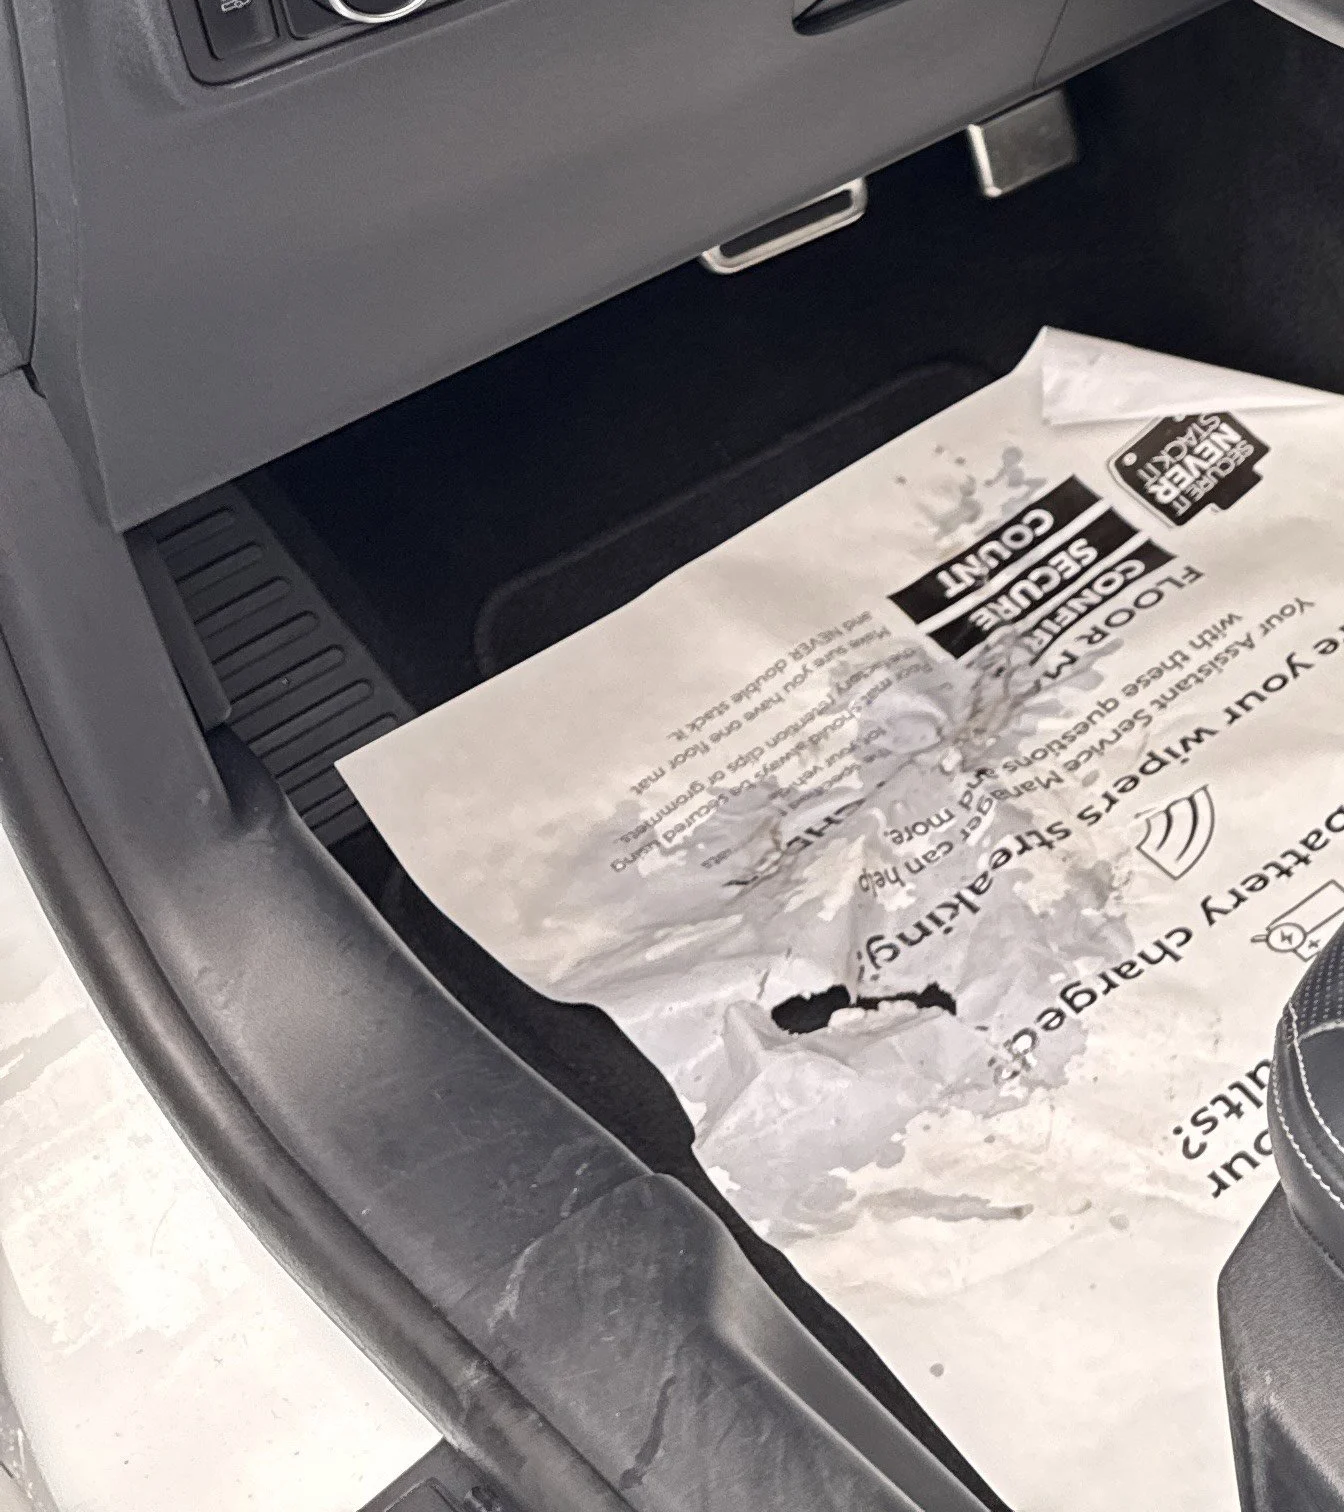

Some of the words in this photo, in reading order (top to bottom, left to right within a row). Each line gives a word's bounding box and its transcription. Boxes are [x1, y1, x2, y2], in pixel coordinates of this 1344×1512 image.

[1146, 421, 1242, 504] NEVER
[1151, 415, 1221, 470] STACK
[1136, 461, 1162, 489] IT
[1184, 436, 1255, 502] SECURE
[1167, 491, 1192, 517] IT
[936, 508, 1055, 598] COUNT
[968, 537, 1099, 631] SECURE
[1021, 549, 1145, 654] CONFIR
[1076, 565, 1204, 646] FLOOR
[841, 610, 873, 633] and
[1188, 612, 1243, 650] with
[1259, 596, 1315, 637] Your
[787, 625, 845, 662] NEVER
[813, 644, 850, 668] sure
[729, 658, 788, 705] double
[781, 664, 814, 695] you
[1120, 649, 1191, 698] these
[1149, 631, 1256, 712] Assistant
[1223, 651, 1314, 726] your
[684, 700, 730, 733] stack
[742, 691, 786, 722] have
[763, 692, 837, 749] retention
[667, 740, 711, 770] floor
[709, 719, 743, 744] one
[1001, 697, 1120, 775] questions
[1062, 708, 1153, 773] Service
[629, 766, 667, 796] mat
[725, 745, 766, 774] clips
[1076, 726, 1219, 827] wipers
[957, 766, 998, 812] and
[958, 769, 1065, 843] Manager
[661, 788, 731, 844] secured
[857, 865, 906, 897] help
[903, 839, 955, 876] can
[1172, 1059, 1282, 1160] ults?
[1207, 1127, 1284, 1199] our
